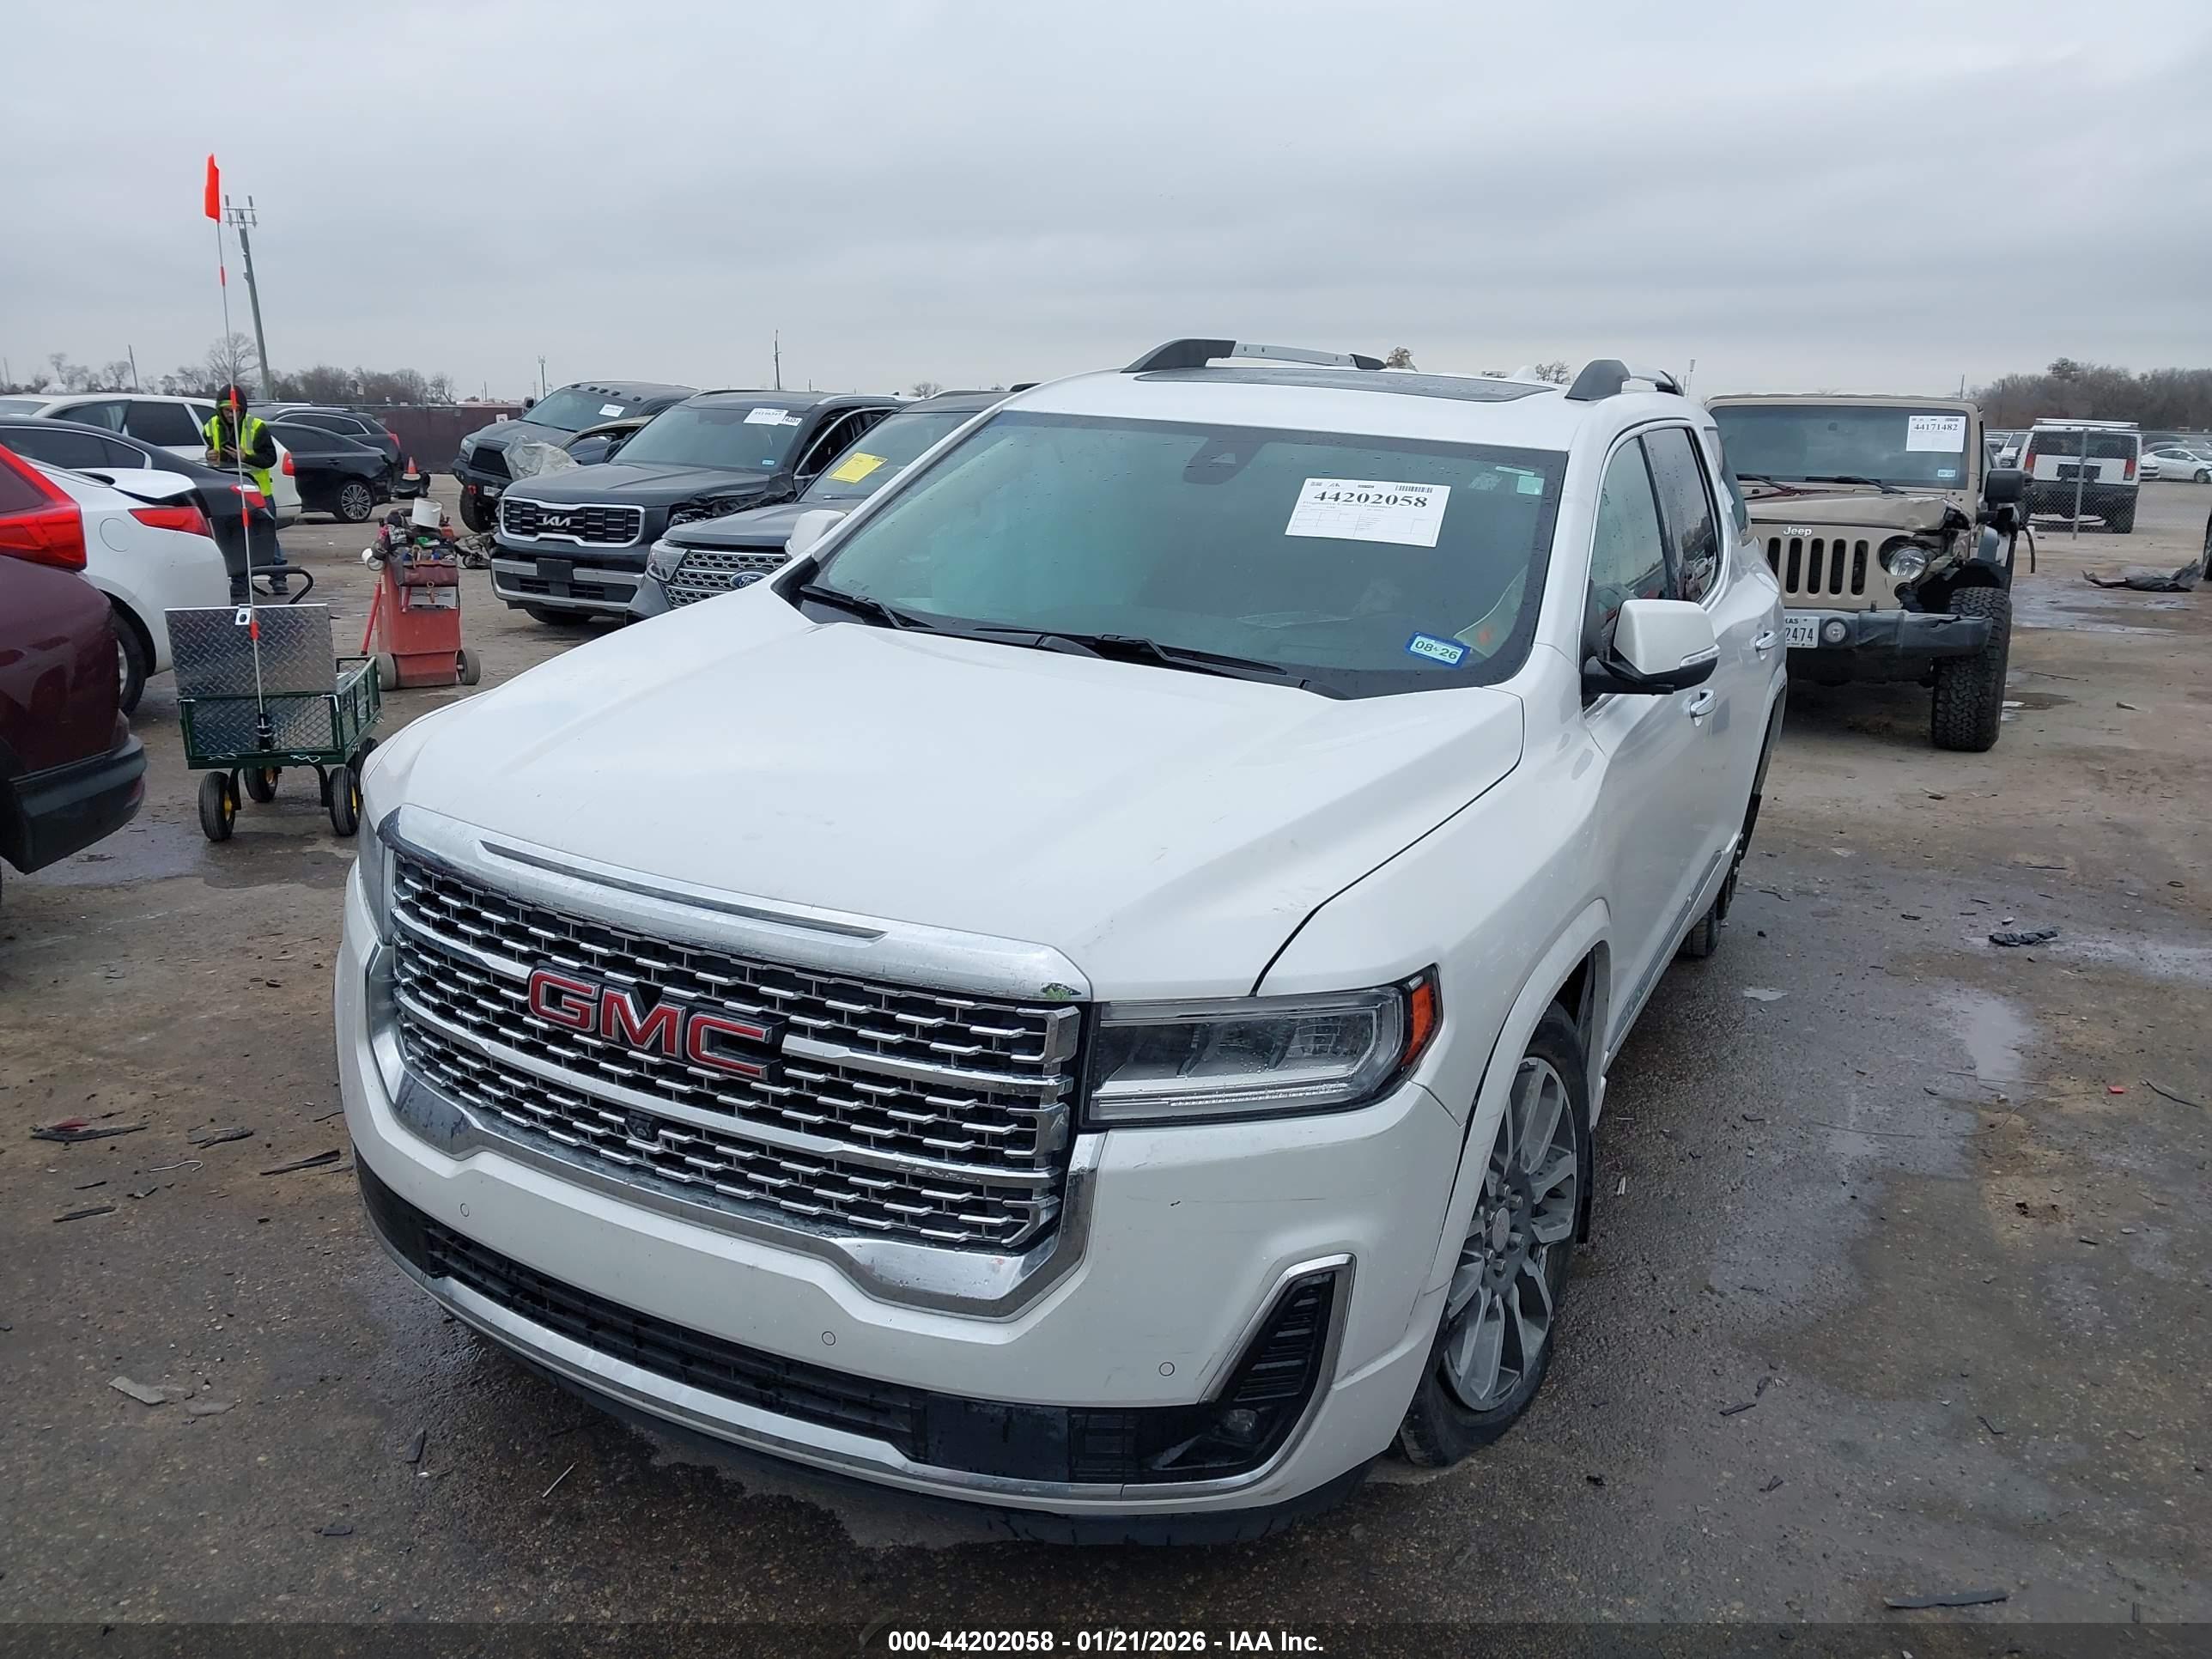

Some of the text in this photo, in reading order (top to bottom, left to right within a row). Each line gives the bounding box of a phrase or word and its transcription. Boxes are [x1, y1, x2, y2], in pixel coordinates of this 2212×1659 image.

[1313, 490, 1429, 508] 44202058
[1783, 526, 1813, 537] Jeep
[1785, 627, 1814, 642] 2474
[528, 969, 774, 1081] GMC
